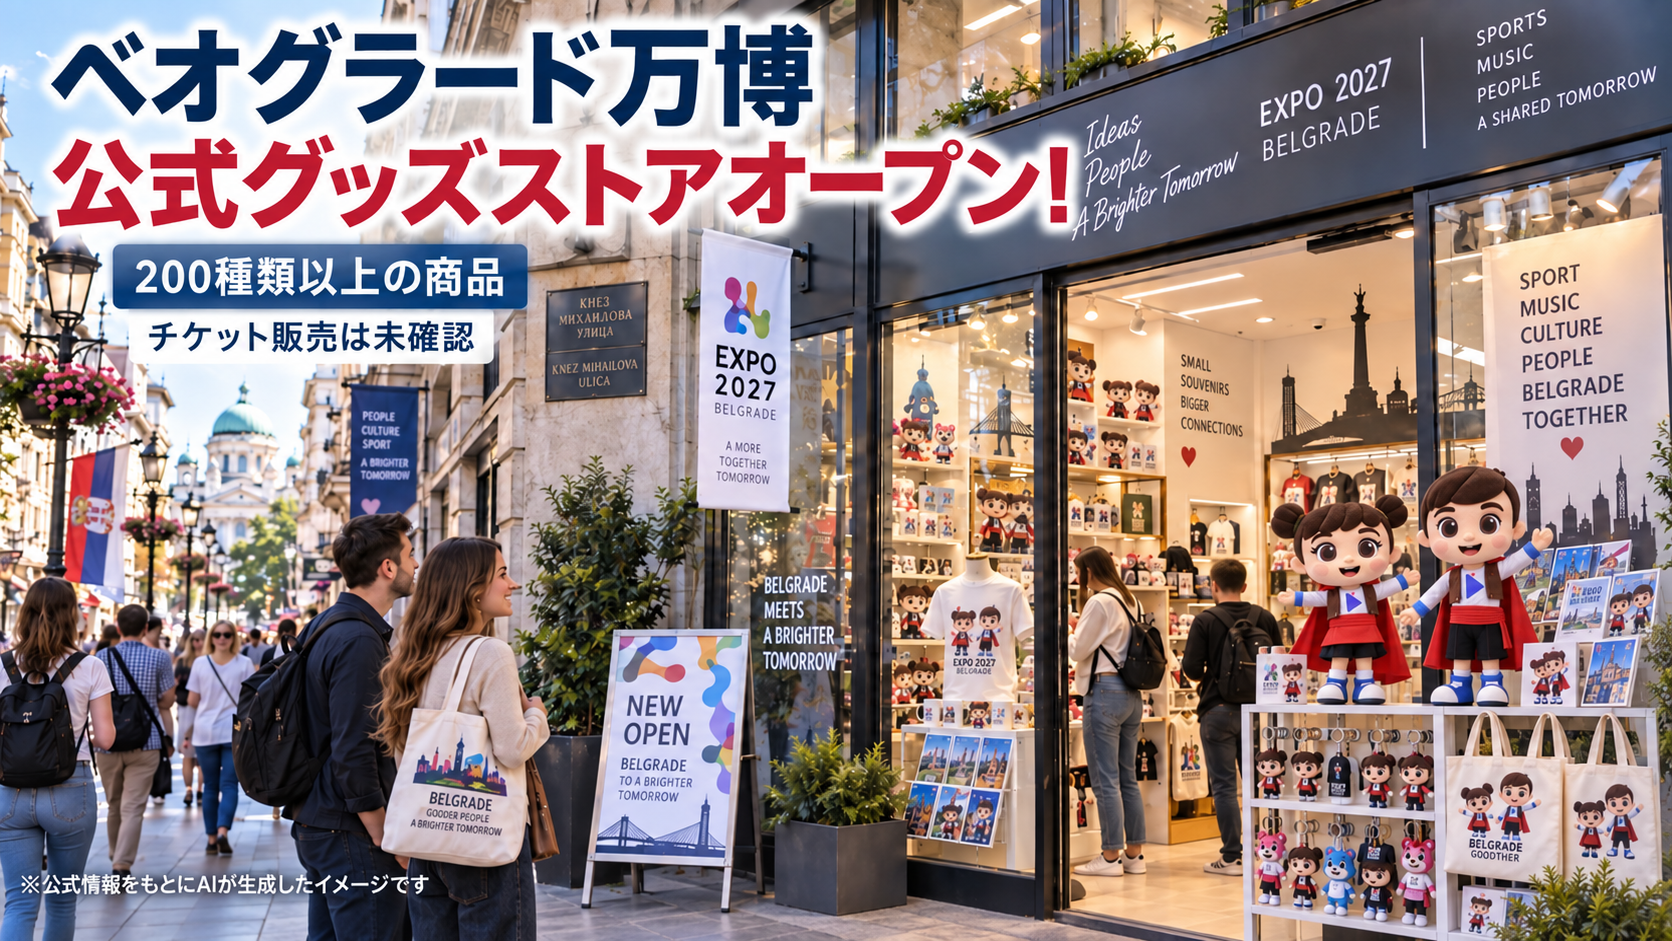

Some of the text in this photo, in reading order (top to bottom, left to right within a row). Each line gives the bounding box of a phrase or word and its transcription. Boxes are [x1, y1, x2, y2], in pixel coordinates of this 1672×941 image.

[1476, 8, 1547, 47] SPORTS
[1477, 43, 1534, 74] MUSIC
[1259, 57, 1392, 127] EXPO 2027
[1477, 71, 1541, 103] PEOPLE
[1477, 66, 1657, 130] A SHARED TOMORROW
[1083, 113, 1142, 158] Ideas
[1263, 106, 1380, 162] BELGRADE
[1085, 139, 1152, 197] People
[1072, 152, 1238, 240] A Brighter Tomorrow
[1520, 264, 1580, 290] SPORT
[580, 296, 610, 309] КНЕЗ
[1520, 292, 1580, 317] MUSIC
[577, 326, 613, 338] УЛИЦА
[1520, 317, 1603, 344] CULTURE
[552, 359, 638, 375] KNEZ MIHAILOVA
[715, 345, 777, 376] EXPO
[1181, 354, 1211, 372] SMALL
[1521, 347, 1593, 373] PEOPLE
[578, 376, 611, 388] ULICA
[715, 374, 776, 401] 2027
[1181, 374, 1230, 396] SOUVENIRS
[1522, 374, 1624, 402] BELGRADE
[714, 403, 777, 421] BELGRADE
[1181, 395, 1210, 412] BIGGER
[362, 411, 395, 422] PEOPLE
[1522, 403, 1628, 429] TOGETHER
[361, 425, 400, 436] CULTURE
[1181, 417, 1244, 437] CONNECTIONS
[362, 439, 391, 449] SPORT
[725, 441, 761, 454] A MORE
[360, 458, 409, 468] A BRIGHTER
[719, 456, 767, 470] TOGETHER
[360, 470, 410, 480] TOMORROW
[716, 471, 770, 484] TOMORROW
[764, 575, 828, 594] BELGRADE
[764, 601, 804, 619] MEETS
[763, 626, 835, 645] A BRIGHTER
[763, 651, 838, 671] TOMORROW
[953, 658, 996, 667] EXPO 2027
[626, 695, 684, 717] NEW
[623, 723, 690, 746] OPEN
[620, 758, 687, 772] BELGRADE
[619, 776, 693, 788] TO A BRIGHTER
[429, 791, 493, 811] BELGRADE
[618, 790, 680, 802] TOMORROW
[426, 808, 490, 823] GOODER PEOPLE
[410, 819, 502, 836] A BRIGHTER TOMORROW
[1469, 838, 1523, 853] BELGRADE
[1470, 850, 1520, 862] GOODTHER
